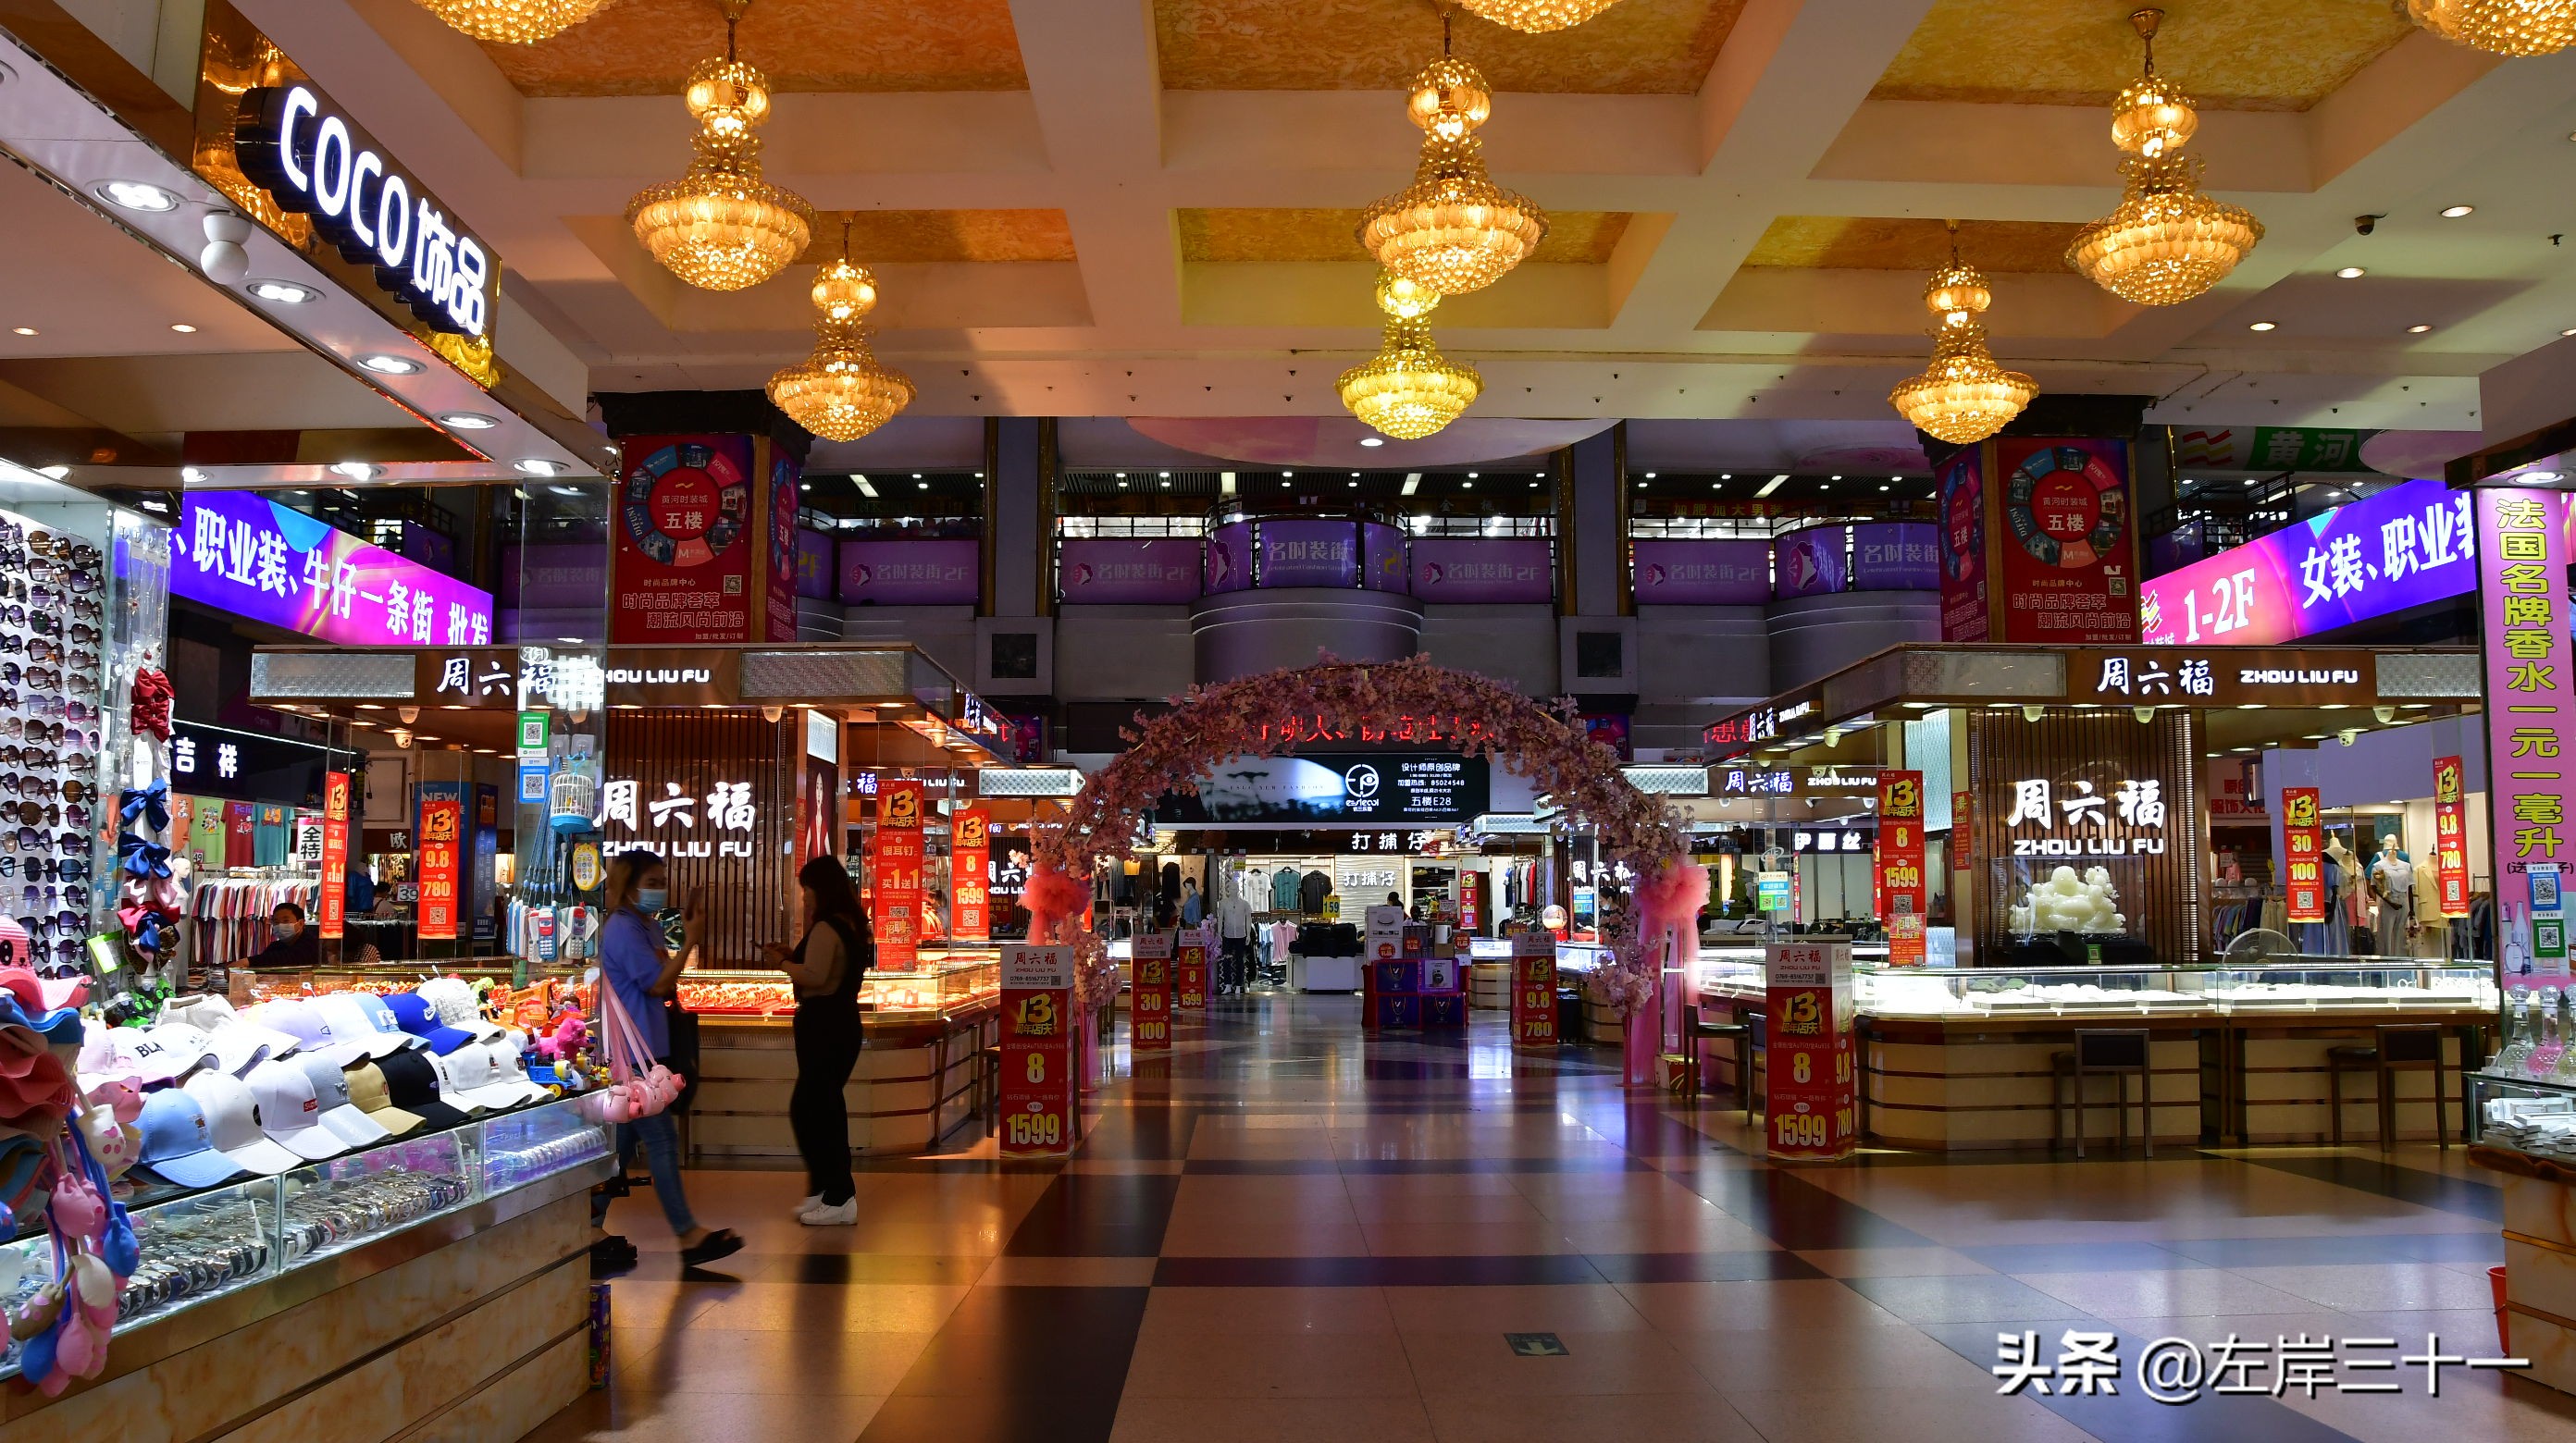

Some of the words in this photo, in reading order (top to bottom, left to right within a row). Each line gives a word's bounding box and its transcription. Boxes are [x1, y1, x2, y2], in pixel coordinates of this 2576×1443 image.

[280, 86, 410, 268] COCO
[414, 196, 487, 337] 饰品
[2267, 430, 2355, 465] 黄河
[662, 495, 709, 504] 黄河时装城
[664, 512, 703, 530] 五楼
[2048, 513, 2085, 532] 五楼
[1269, 540, 1348, 561] 名时装街
[1864, 543, 1939, 564] 名时装街
[876, 563, 941, 580] 名时装街
[945, 566, 969, 581] 2F
[1098, 563, 1163, 579] 名时装街
[1166, 566, 1191, 581] 2F
[1448, 562, 1512, 580] 名时装街
[1517, 566, 1540, 581] 2F
[1671, 563, 1734, 580] 名时装街
[1738, 566, 1762, 581] 2F
[644, 578, 696, 586] 时尚品牌中心
[2033, 579, 2083, 587] 时尚品牌中心
[622, 592, 720, 609] 时尚品牌荟萃
[2012, 593, 2107, 610] 时尚品牌荟萃
[2184, 567, 2256, 644] 1-2F
[448, 601, 489, 646] 批发
[647, 611, 744, 628] 潮流风尚前沿
[2037, 612, 2131, 629] 潮流风尚前沿
[606, 669, 642, 684] HOU
[646, 669, 678, 684] LIU
[682, 669, 711, 684] FU
[2098, 657, 2214, 696] 周六福
[2240, 669, 2295, 684] ZHOU
[2298, 669, 2331, 684] LIU
[2333, 669, 2359, 684] FU
[2496, 499, 2564, 857] 法国名牌香水一元一毫升
[175, 736, 238, 779] 吉祥
[1401, 762, 1461, 772] 设计师原创品牌
[1725, 771, 1792, 793] 周六福
[1840, 777, 1860, 786] LIU
[1861, 777, 1877, 786] FU
[2437, 766, 2455, 795] 13
[1411, 796, 1452, 807] 五楼E28
[1885, 780, 1914, 808] 13
[593, 780, 756, 832] 周六福
[884, 790, 915, 817] 13
[1884, 806, 1916, 817] 周年店庆
[2007, 779, 2166, 830] 周六福
[2289, 796, 2313, 818] 13
[427, 808, 452, 832] 13
[881, 817, 915, 827] 周年店庆
[957, 816, 982, 839] 13
[2439, 814, 2458, 835] 9.8
[1352, 832, 1427, 851] 打捕仔
[1896, 827, 1908, 848] 8
[2292, 834, 2312, 853] 30
[673, 841, 710, 857] LIU
[720, 841, 752, 857] FU
[882, 845, 913, 857] 银耳钉
[2013, 838, 2082, 856] ZHOU
[2087, 838, 2125, 855] LIU
[2133, 838, 2164, 855] FU
[193, 852, 203, 862] 49
[426, 851, 450, 868] 9.8
[966, 855, 976, 872] 8
[2440, 850, 2461, 870] 780
[2290, 862, 2317, 881] 100
[2507, 861, 2574, 875] (送子)
[882, 869, 919, 889] 买1送1
[1343, 870, 1396, 887] 打捕仔
[1884, 867, 1918, 888] 1599
[399, 889, 419, 901] 39
[423, 882, 451, 896] 780
[956, 887, 985, 905] 1599
[1323, 900, 1340, 913] 159
[1139, 937, 1163, 945] 周六福
[1014, 952, 1058, 966] 周六福
[1779, 949, 1822, 963] 周六福
[1142, 960, 1161, 980] 13
[1189, 970, 1196, 982] 8
[1019, 993, 1052, 1024] 13
[1140, 993, 1161, 1011] 30
[1181, 993, 1202, 1006] 1599
[1526, 991, 1551, 1009] 9.8
[1784, 992, 1818, 1023] 13
[1015, 1023, 1053, 1035] 周年店庆
[1137, 1022, 1166, 1040] 100
[1524, 1021, 1553, 1037] 780
[1782, 1022, 1819, 1035] 周年店庆
[1026, 1053, 1045, 1084] 8
[1793, 1052, 1811, 1084] 8
[1836, 1052, 1851, 1085] 9.8
[1007, 1113, 1060, 1145] 1599
[1774, 1114, 1827, 1147] 1599
[1835, 1107, 1852, 1139] 780
